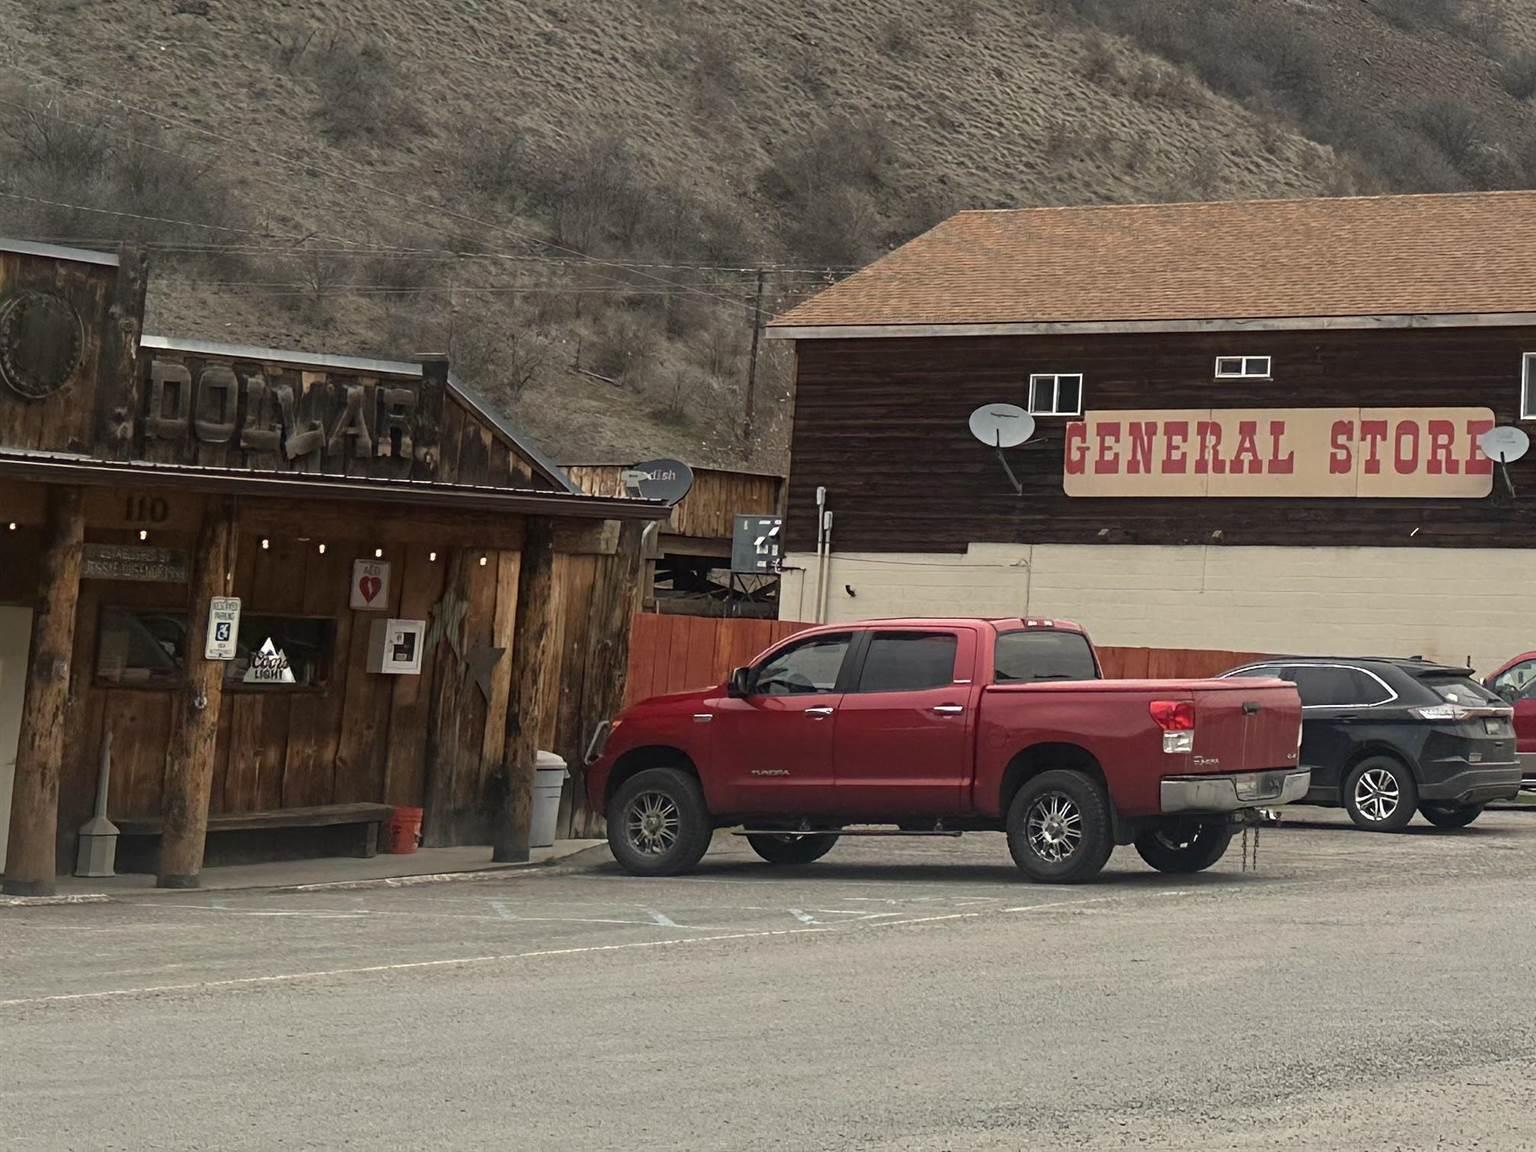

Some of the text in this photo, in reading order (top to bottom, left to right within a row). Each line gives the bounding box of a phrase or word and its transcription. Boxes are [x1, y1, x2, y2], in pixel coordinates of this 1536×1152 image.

[1065, 419, 1495, 476] GENERAL STORE
[649, 469, 676, 481] dish
[125, 496, 169, 523] 110
[254, 669, 284, 680] LIGHT
